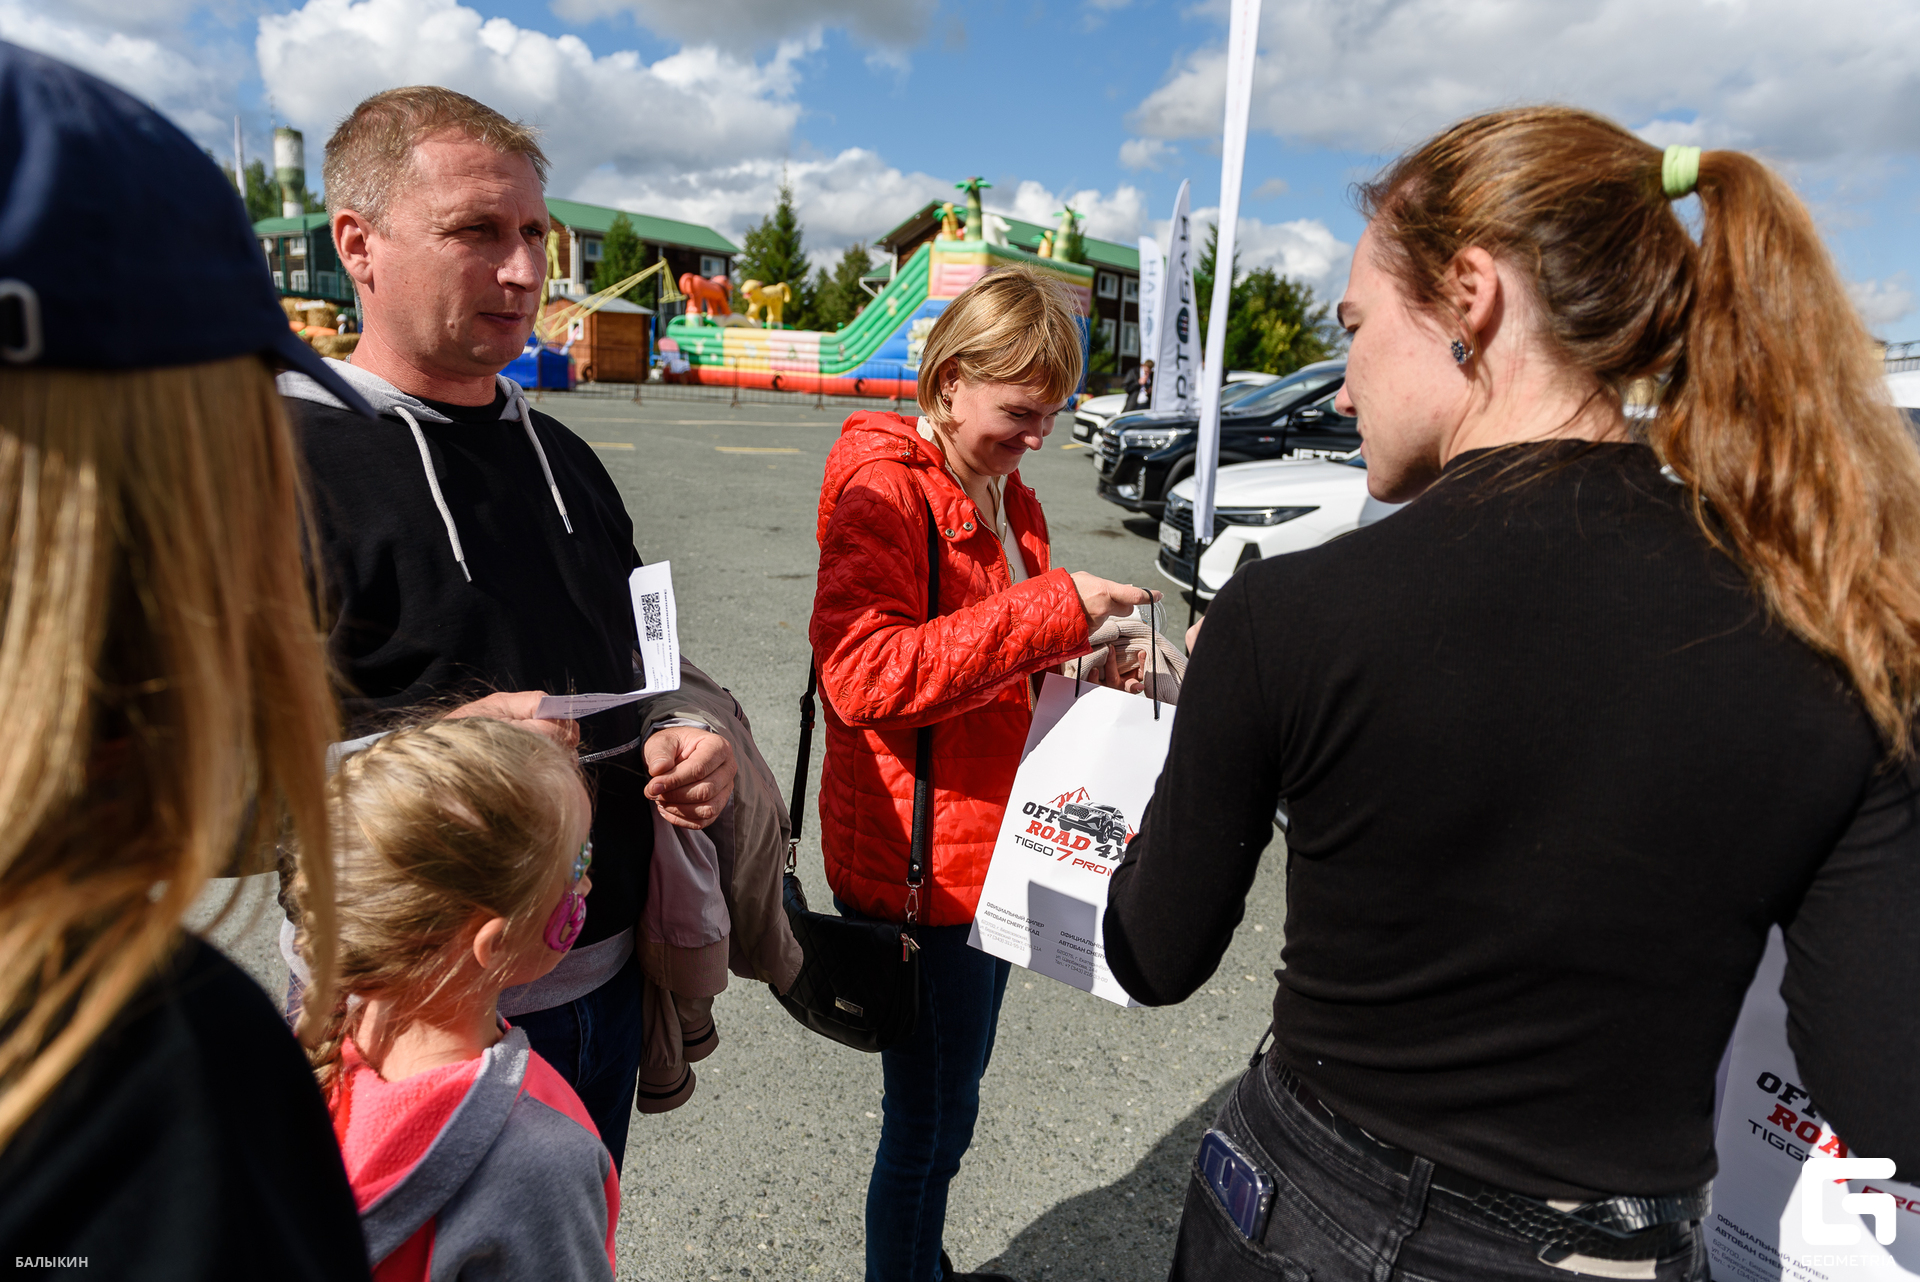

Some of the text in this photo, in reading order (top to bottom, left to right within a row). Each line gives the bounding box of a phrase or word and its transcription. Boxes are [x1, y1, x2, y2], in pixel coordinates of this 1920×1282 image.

[1022, 801, 1060, 824] OFF
[1026, 820, 1092, 851] ROAD
[1014, 834, 1054, 857] TIGGO
[1056, 847, 1074, 861] 7
[1072, 858, 1107, 875] PRO
[984, 910, 1006, 923] АВТОБАН
[1006, 919, 1024, 930] CHERY
[986, 902, 1045, 928] ОФИЦИАЛЬНЫЙ ДИЛЕР
[1058, 939, 1086, 953] АВТОБАН
[1060, 930, 1104, 950] ОФИЦИАЛЬНЫ
[1748, 1119, 1814, 1162] TIGG
[1715, 1226, 1757, 1256] АВТОБАН
[1758, 1252, 1791, 1274] CHERY
[1716, 1213, 1791, 1262] ОФИЦИАЛЬНЫЙ
